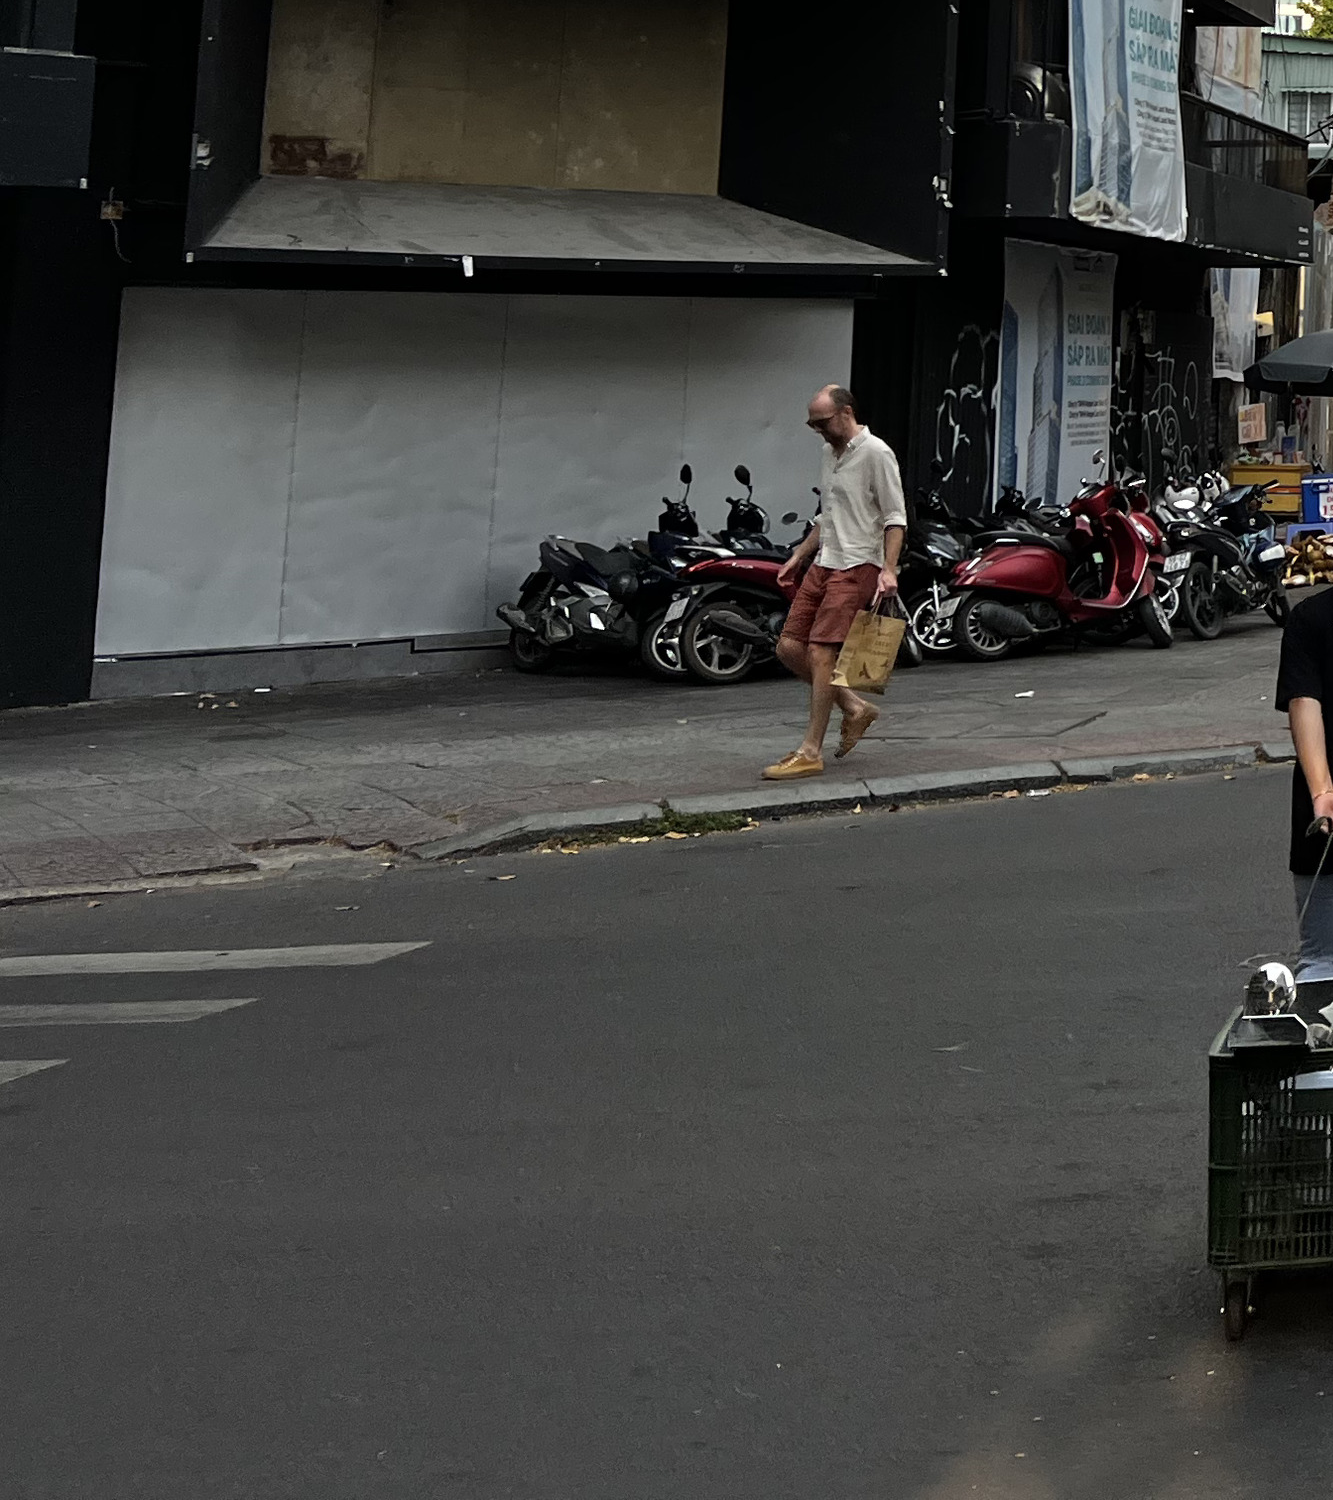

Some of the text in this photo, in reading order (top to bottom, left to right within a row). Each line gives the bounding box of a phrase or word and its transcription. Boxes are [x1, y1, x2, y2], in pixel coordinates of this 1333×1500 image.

[1129, 5, 1148, 34] GIAI
[1148, 46, 1159, 71] RA
[1067, 313, 1084, 335] GIAI
